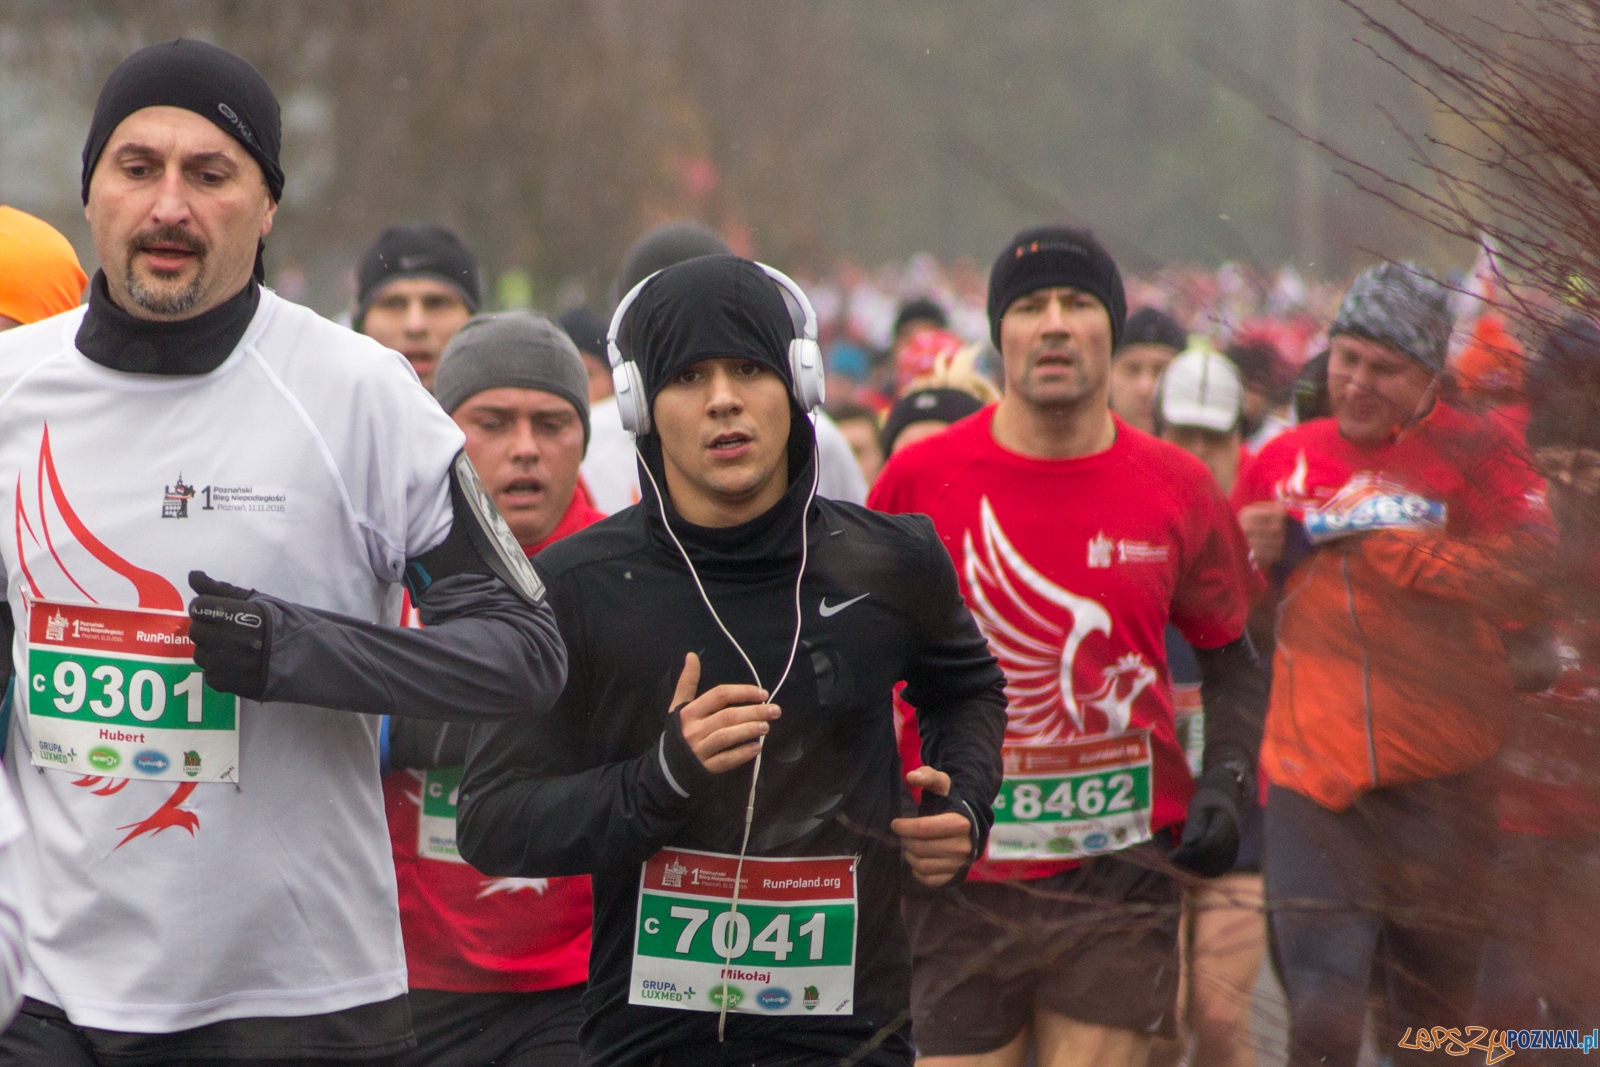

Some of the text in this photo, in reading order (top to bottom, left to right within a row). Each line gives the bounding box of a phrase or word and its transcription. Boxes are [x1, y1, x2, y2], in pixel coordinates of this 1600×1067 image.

[201, 485, 214, 510] 1
[213, 494, 286, 502] Bieg Niepodległości
[72, 619, 80, 638] 1
[53, 660, 204, 723] 9301
[99, 728, 145, 743] Hubert
[39, 741, 62, 753] GRUPA
[40, 750, 68, 764] LUXMED
[1012, 773, 1134, 820] 8462
[691, 868, 700, 885] 1
[763, 878, 840, 889] RunPoland.org
[670, 905, 826, 961] 7041
[721, 969, 771, 984] Mikołaj
[642, 980, 676, 992] GRUPA
[641, 989, 682, 1002] LUXMED
